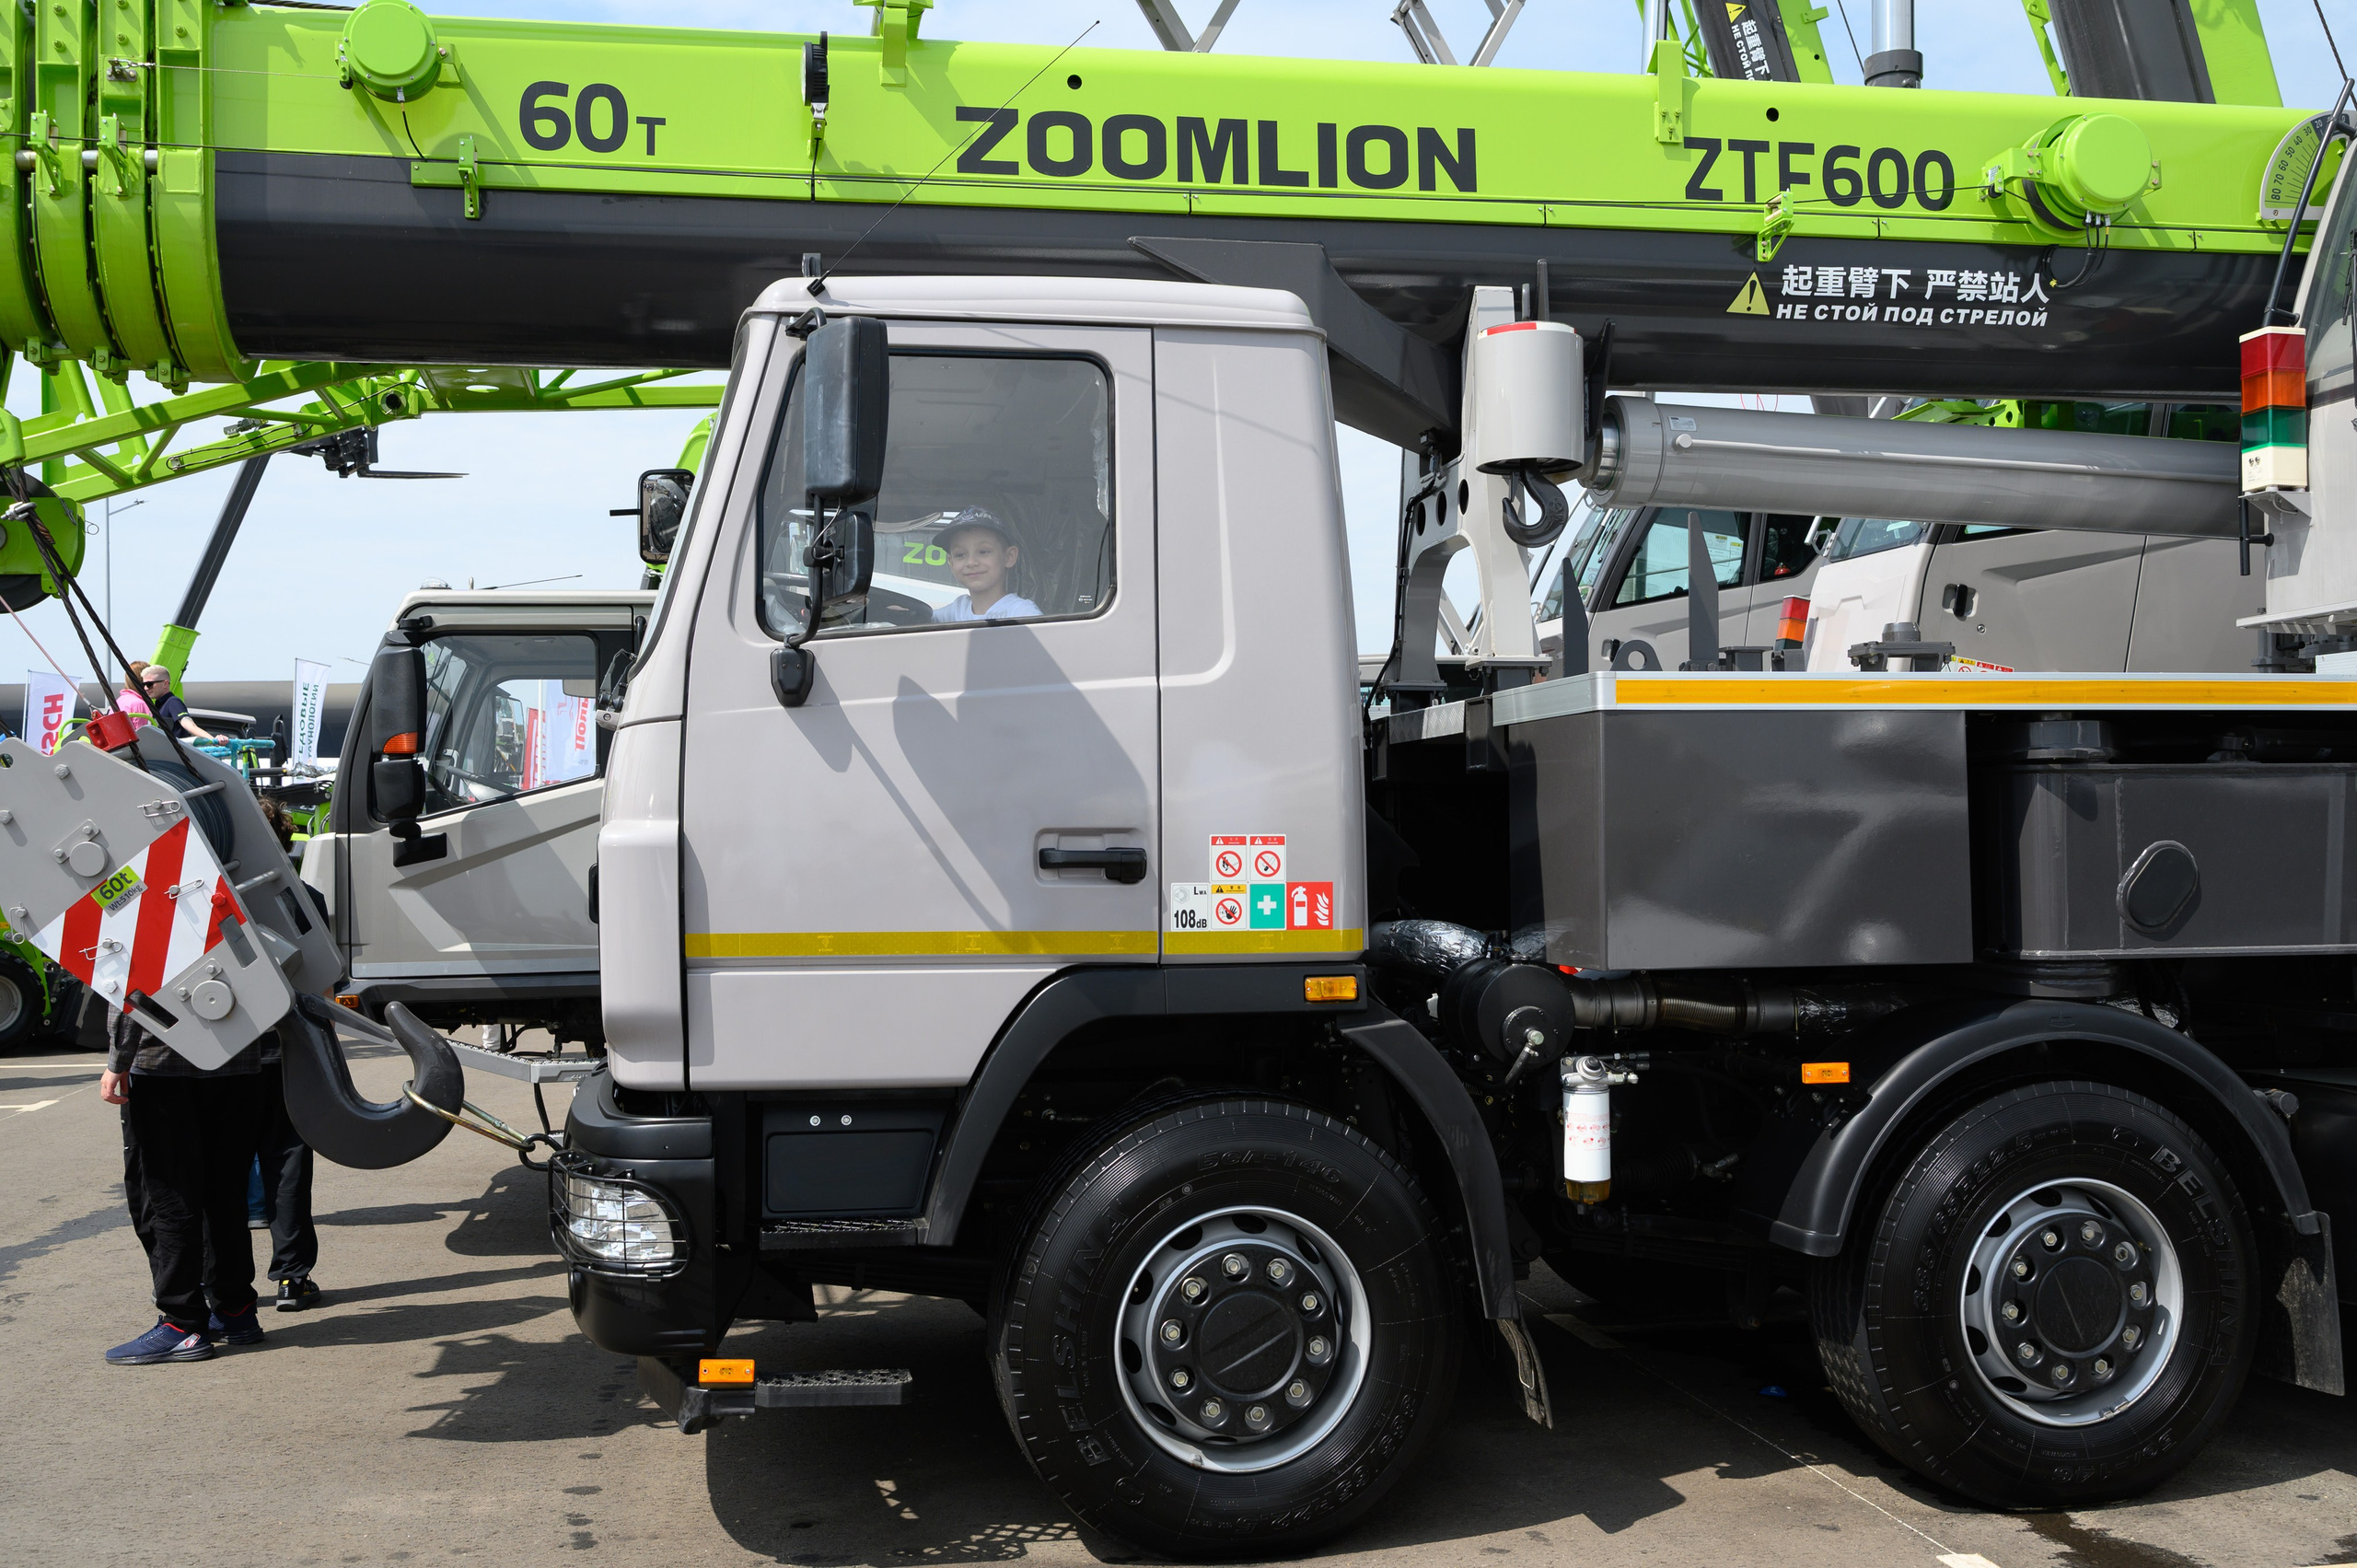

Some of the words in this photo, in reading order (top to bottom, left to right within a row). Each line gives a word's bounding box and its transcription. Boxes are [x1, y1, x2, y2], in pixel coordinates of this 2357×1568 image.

[1731, 24, 1742, 40] НЕ
[1736, 41, 1752, 69] СТОЙ
[2303, 126, 2313, 136] 30
[2315, 119, 2323, 129] 20
[955, 106, 1478, 193] ZOOMLION
[2285, 146, 2295, 158] 50
[2293, 135, 2303, 146] 40
[1683, 136, 1955, 212] ZTF600
[2278, 159, 2289, 171] 60
[2273, 173, 2284, 185] 70
[2270, 188, 2282, 201] 80
[1781, 264, 1911, 300] 起重臂下
[1924, 269, 2050, 305] 严禁站人
[1776, 304, 1807, 319] НЕ
[1814, 302, 1878, 321] СТОЙ
[1883, 306, 1933, 326] ПОД
[1939, 307, 2049, 327] СТРЕЛОЙ
[41, 693, 64, 756] SCH
[99, 872, 133, 900] 60t
[2152, 1144, 2241, 1366] BELSHINA
[1052, 1204, 1130, 1466] BELSHINA
